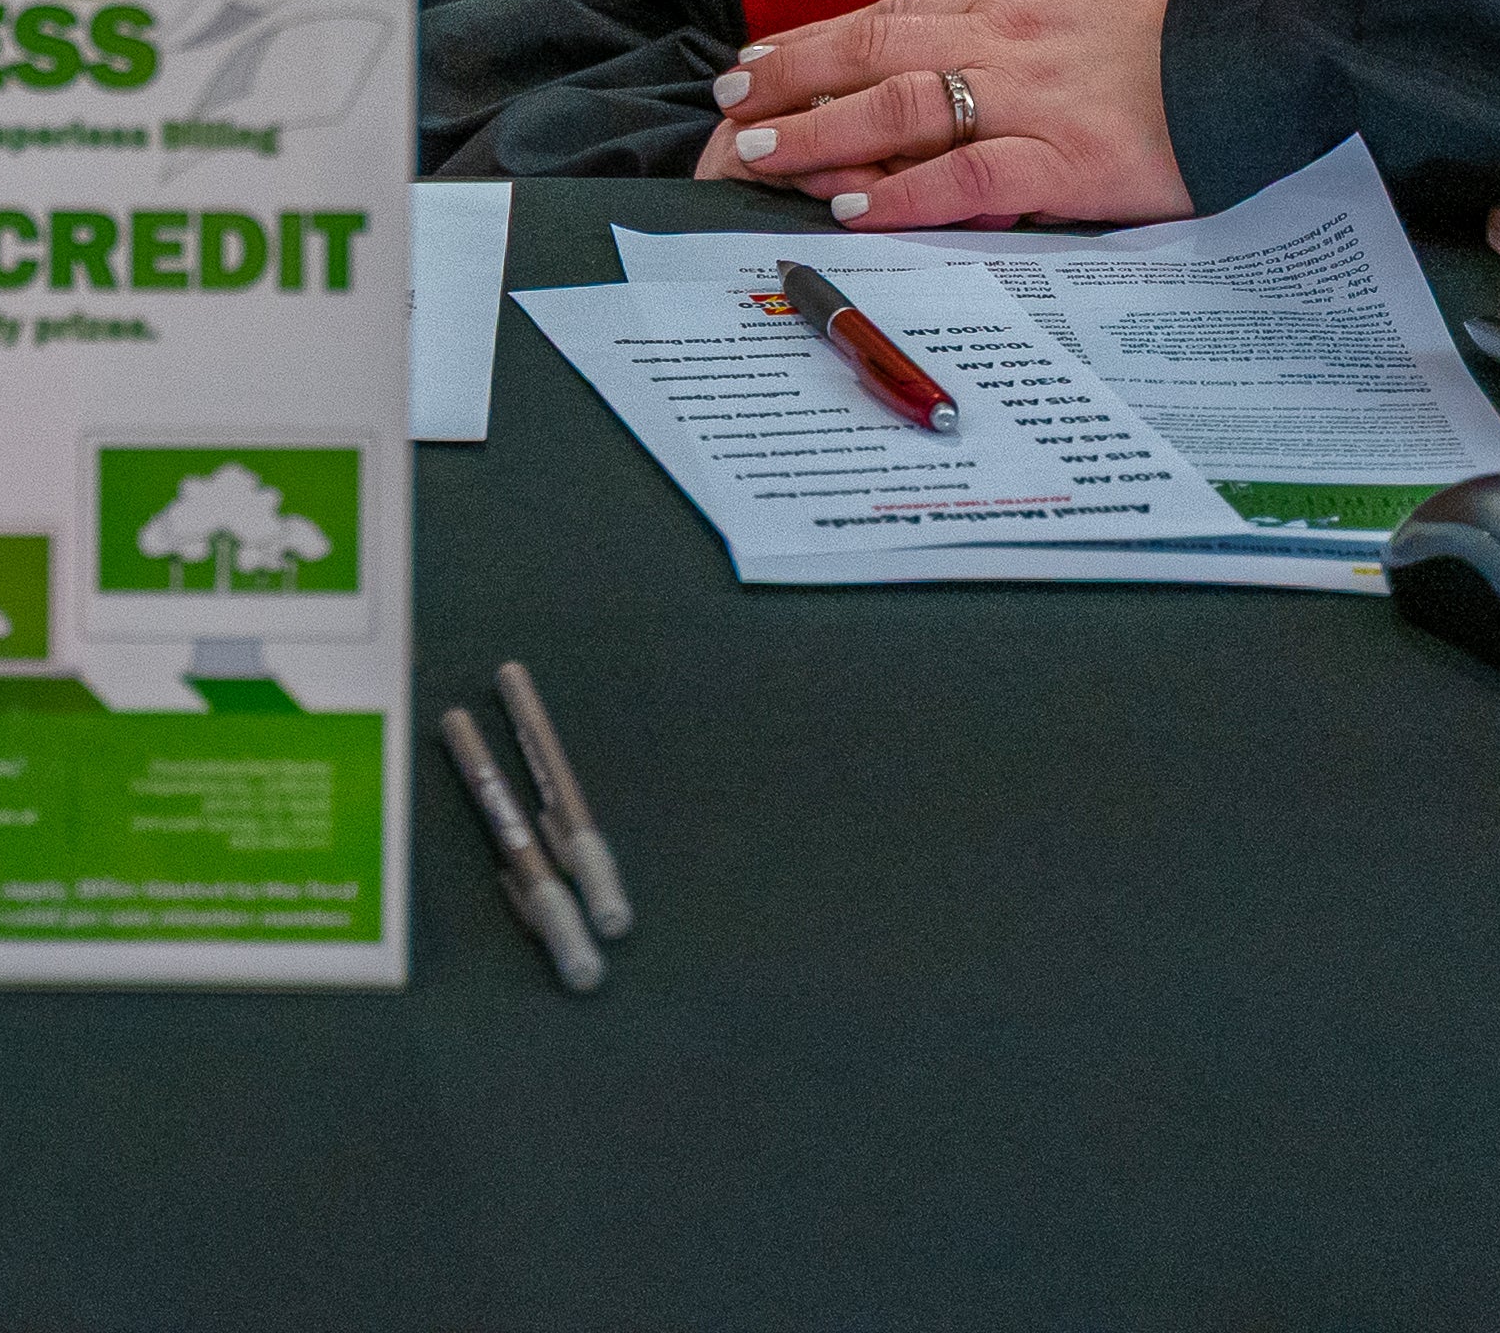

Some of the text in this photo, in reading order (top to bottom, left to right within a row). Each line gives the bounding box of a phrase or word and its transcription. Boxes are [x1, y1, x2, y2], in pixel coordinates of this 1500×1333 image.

[161, 120, 279, 155] Billing
[1218, 212, 1348, 263] and historical usage
[1333, 225, 1354, 241] bill
[1322, 237, 1332, 245] is
[1284, 243, 1321, 259] ready
[1225, 238, 1359, 279] are notified by email
[1330, 251, 1364, 268] Once
[1234, 261, 1264, 270] view
[1272, 267, 1327, 283] enrolled
[1317, 263, 1370, 284] October
[1348, 275, 1373, 287] July
[1348, 286, 1378, 299] April
[33, 314, 157, 345] prizes.
[902, 328, 940, 336] AM
[925, 341, 1033, 353] 10:00 AM
[956, 359, 1052, 370] 9:40 AM
[651, 373, 755, 382] Entertainment
[977, 377, 1071, 389] 9:30 AM
[719, 391, 800, 399] Auditorium
[1001, 396, 1090, 407] 9:15 AM
[688, 412, 732, 422] Demo
[736, 411, 782, 419] Safety
[785, 409, 816, 417] Line
[819, 407, 850, 415] Live
[1015, 414, 1110, 426] 8:50 AM
[761, 427, 853, 438] Environment
[1035, 432, 1130, 445] 8:45 AM
[770, 449, 818, 457] Safety
[821, 447, 852, 455] Line
[1060, 451, 1151, 463] 8:15 AM
[794, 468, 887, 478] Environment
[891, 464, 935, 472] Co-op
[1072, 472, 1172, 485] 8:00 AM
[754, 483, 969, 500] Doors Open, Activities Begin
[814, 503, 1150, 528] Annual Meeting Agenda
